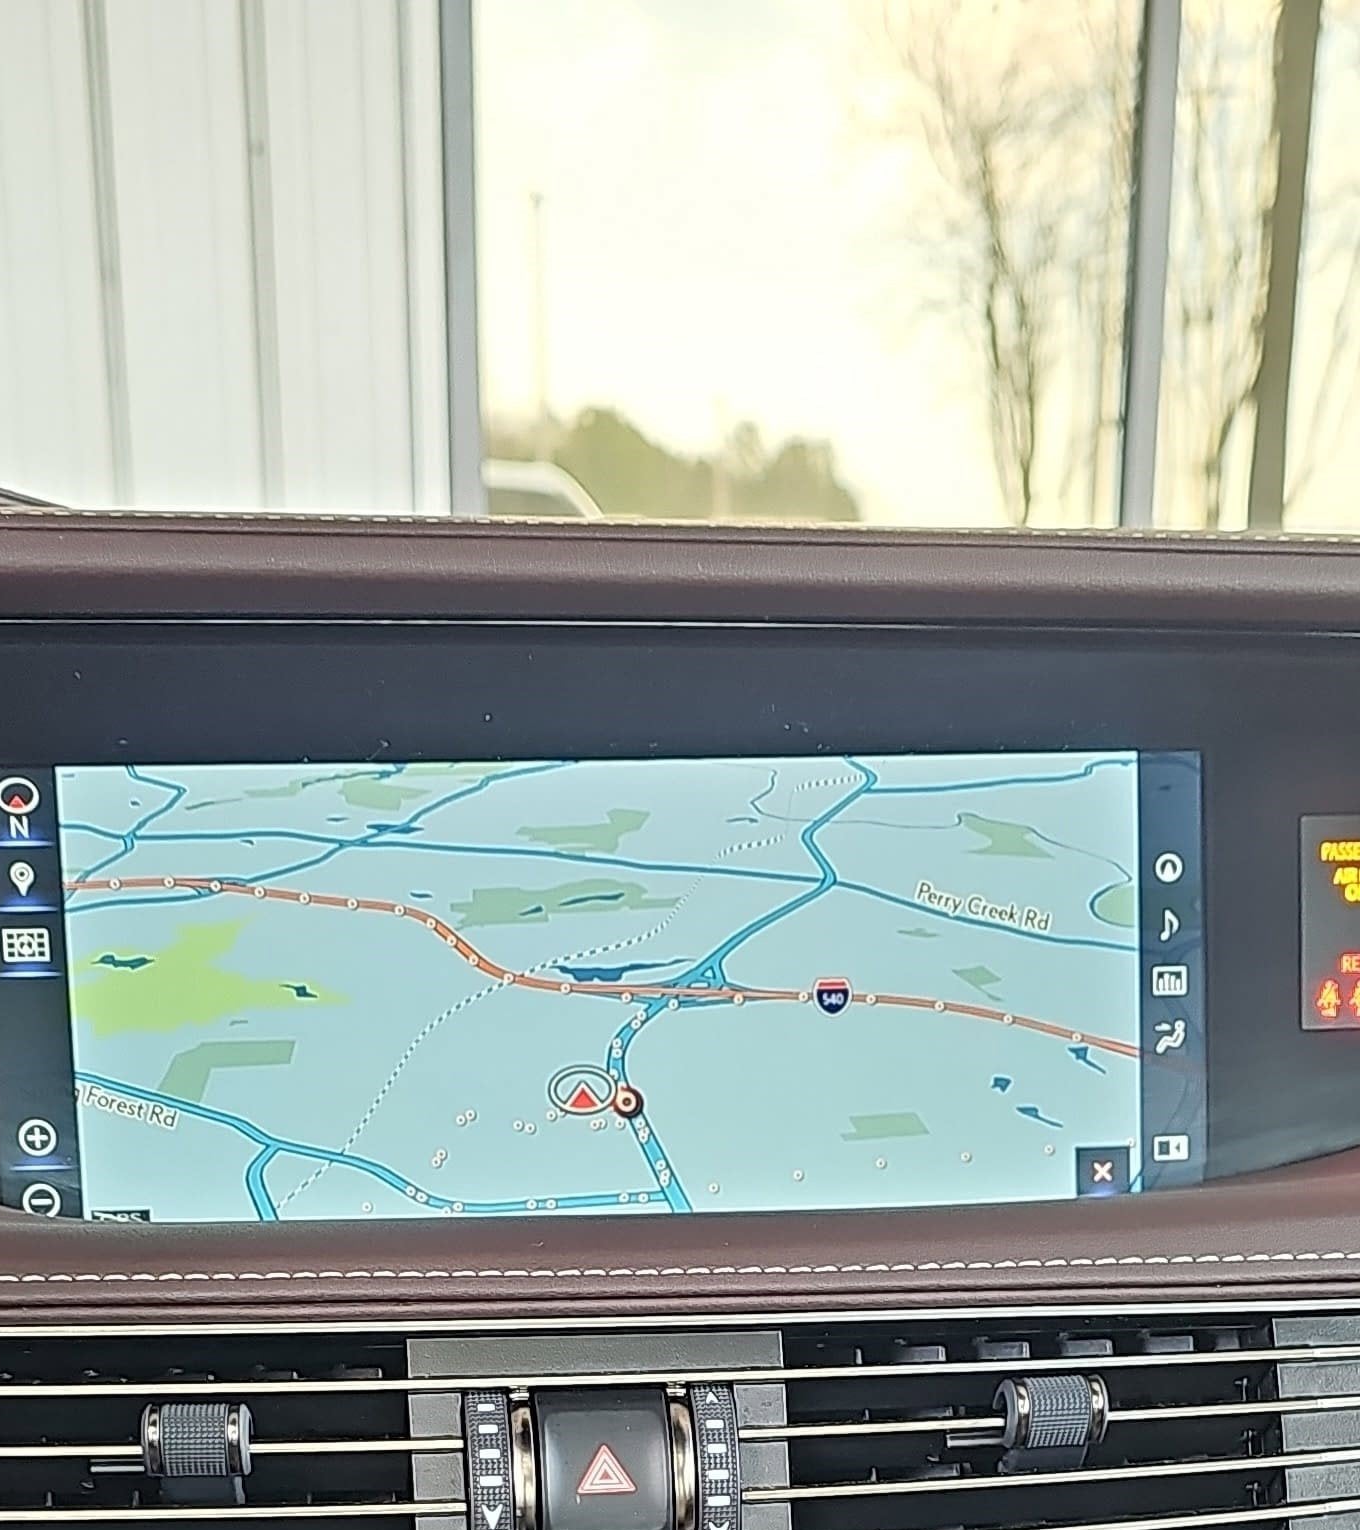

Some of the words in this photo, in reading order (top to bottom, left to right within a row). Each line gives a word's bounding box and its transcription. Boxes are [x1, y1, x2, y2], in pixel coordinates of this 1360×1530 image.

[9, 815, 30, 838] N
[1332, 866, 1358, 885] AIR
[917, 881, 962, 914] Perry
[967, 896, 1017, 923] Creek
[1024, 908, 1050, 931] Rd
[822, 992, 845, 1006] 540
[86, 1085, 144, 1118] Forest
[149, 1104, 178, 1127] Rd
